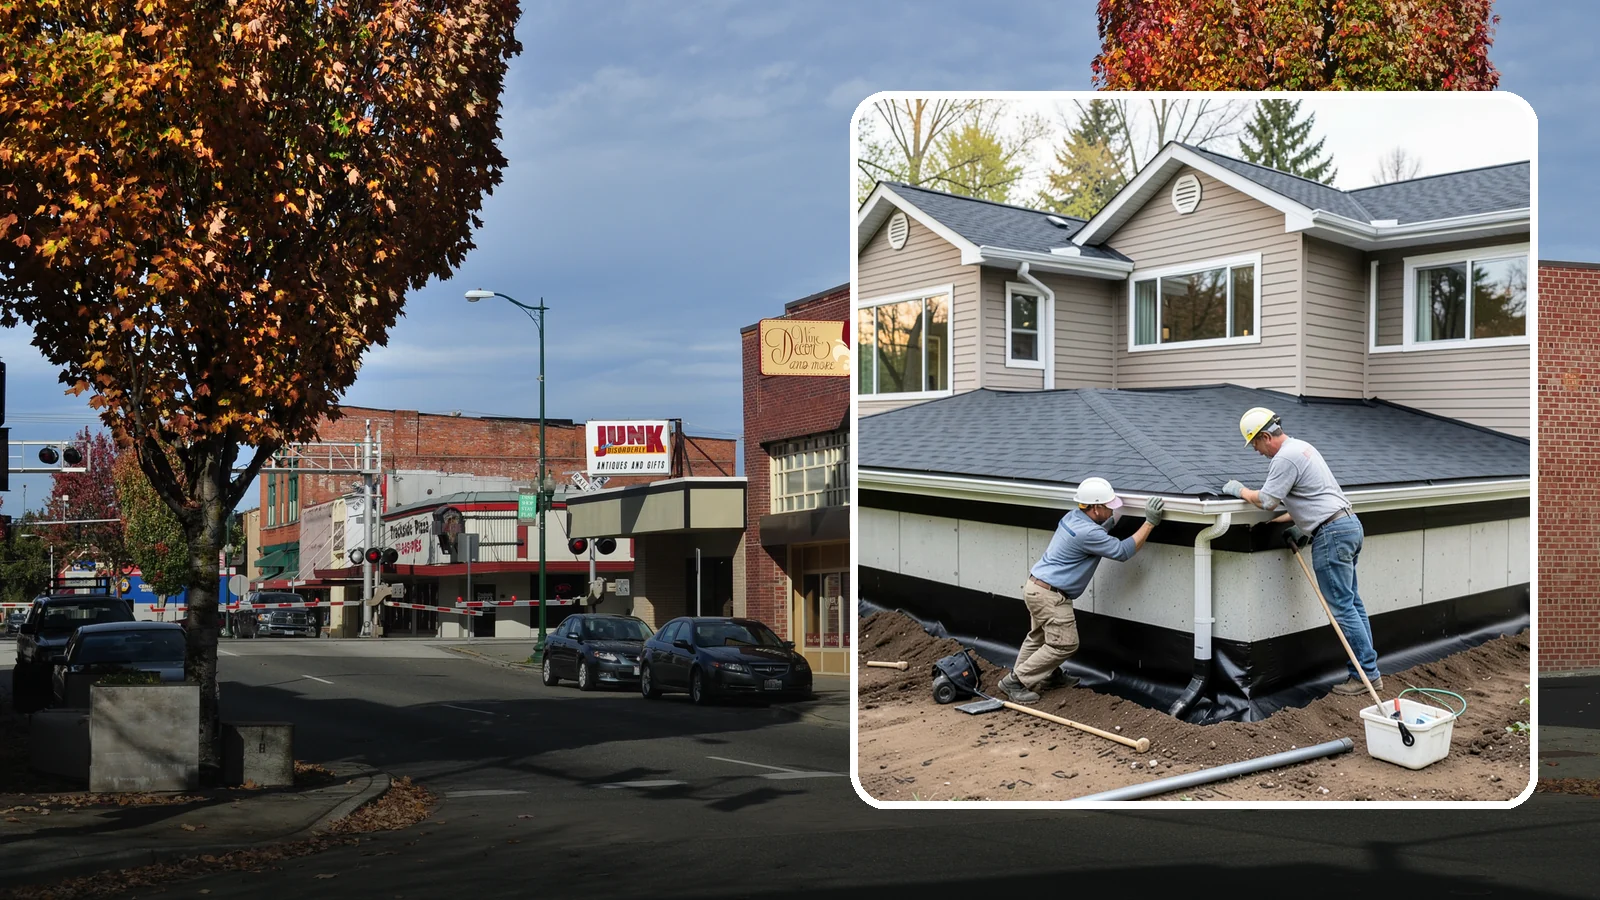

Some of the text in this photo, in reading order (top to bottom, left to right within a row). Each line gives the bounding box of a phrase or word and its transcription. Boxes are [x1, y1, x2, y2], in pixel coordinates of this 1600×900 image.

[596, 425, 665, 457] JUNK
[607, 446, 646, 454] DISORDERLY
[597, 460, 665, 470] ANTIQUES AND GIFTS
[390, 519, 429, 539] Trackside Pizza
